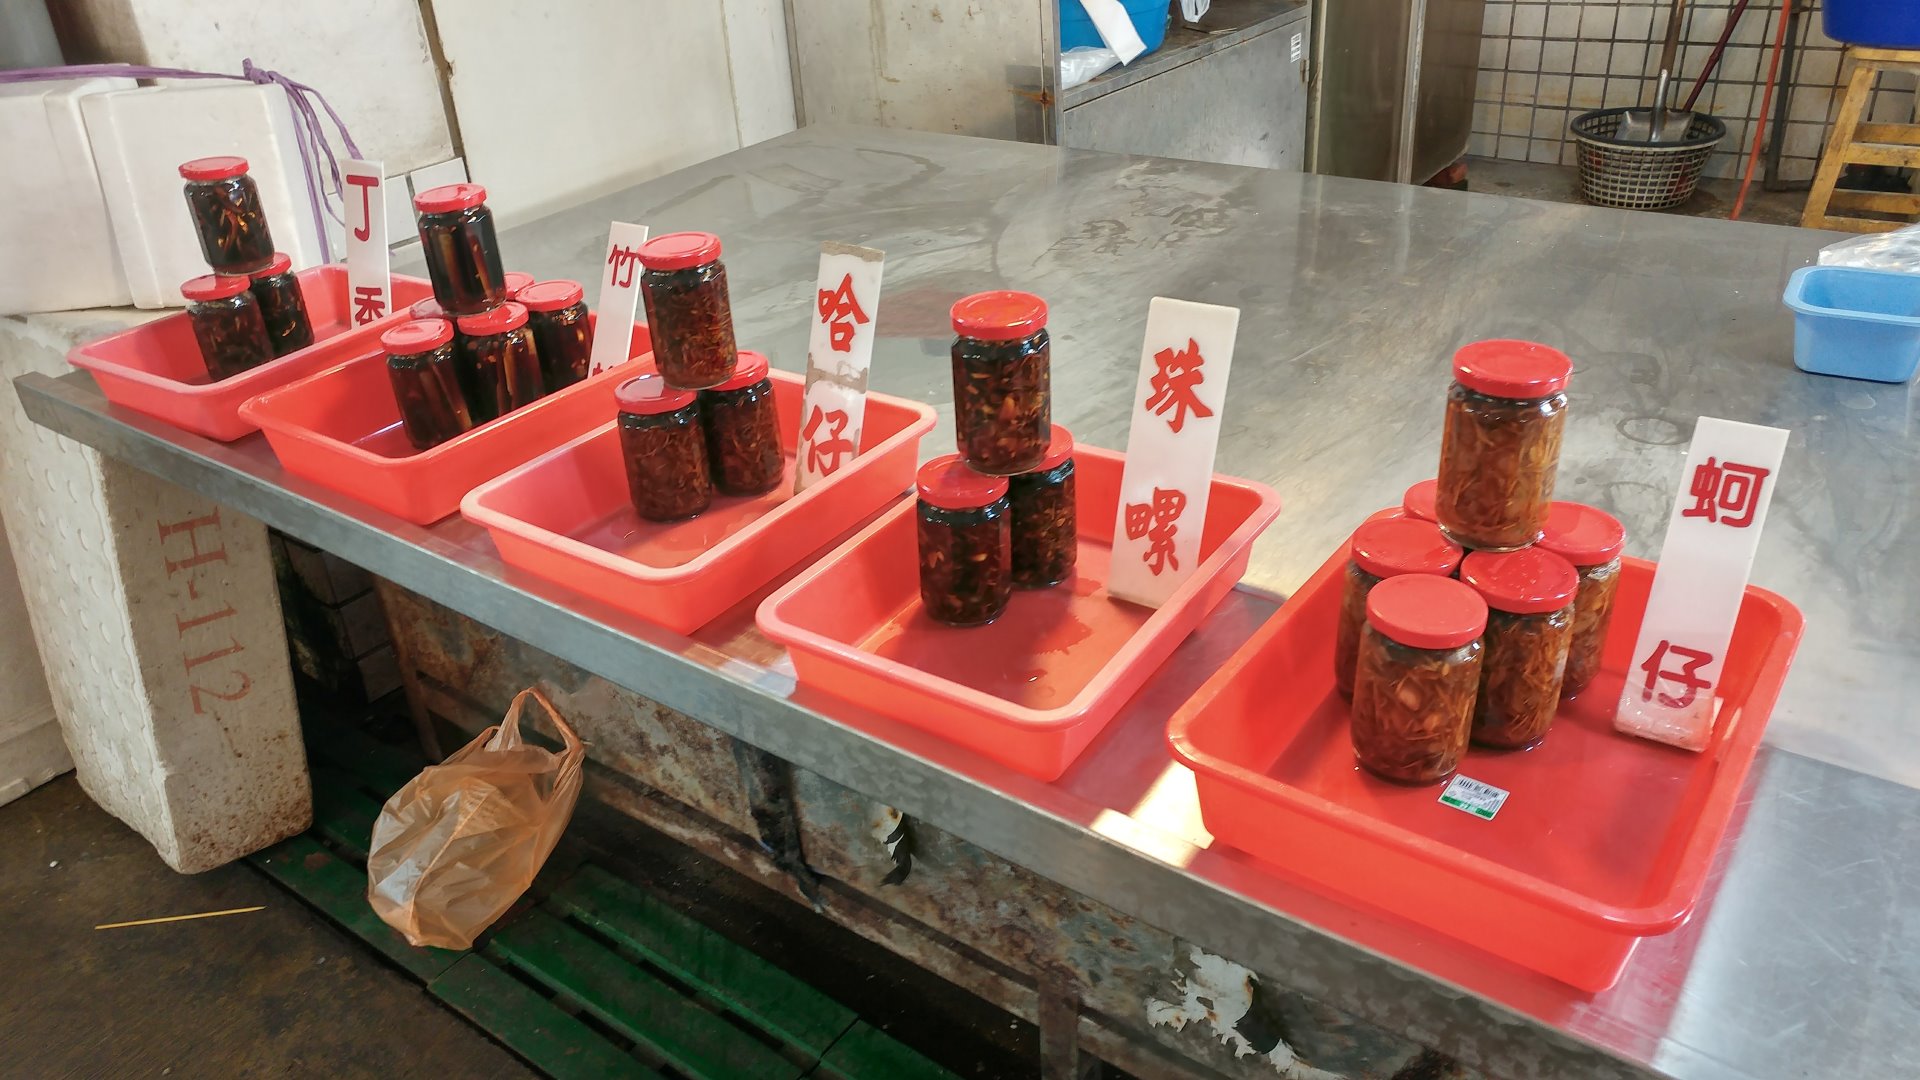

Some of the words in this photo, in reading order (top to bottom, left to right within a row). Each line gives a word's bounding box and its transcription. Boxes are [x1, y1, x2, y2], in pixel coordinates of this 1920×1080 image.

[802, 272, 870, 478] 哈仔
[1125, 336, 1215, 577] 珠螺
[157, 505, 252, 715] H-112
[1640, 456, 1771, 709] 蚵仔
